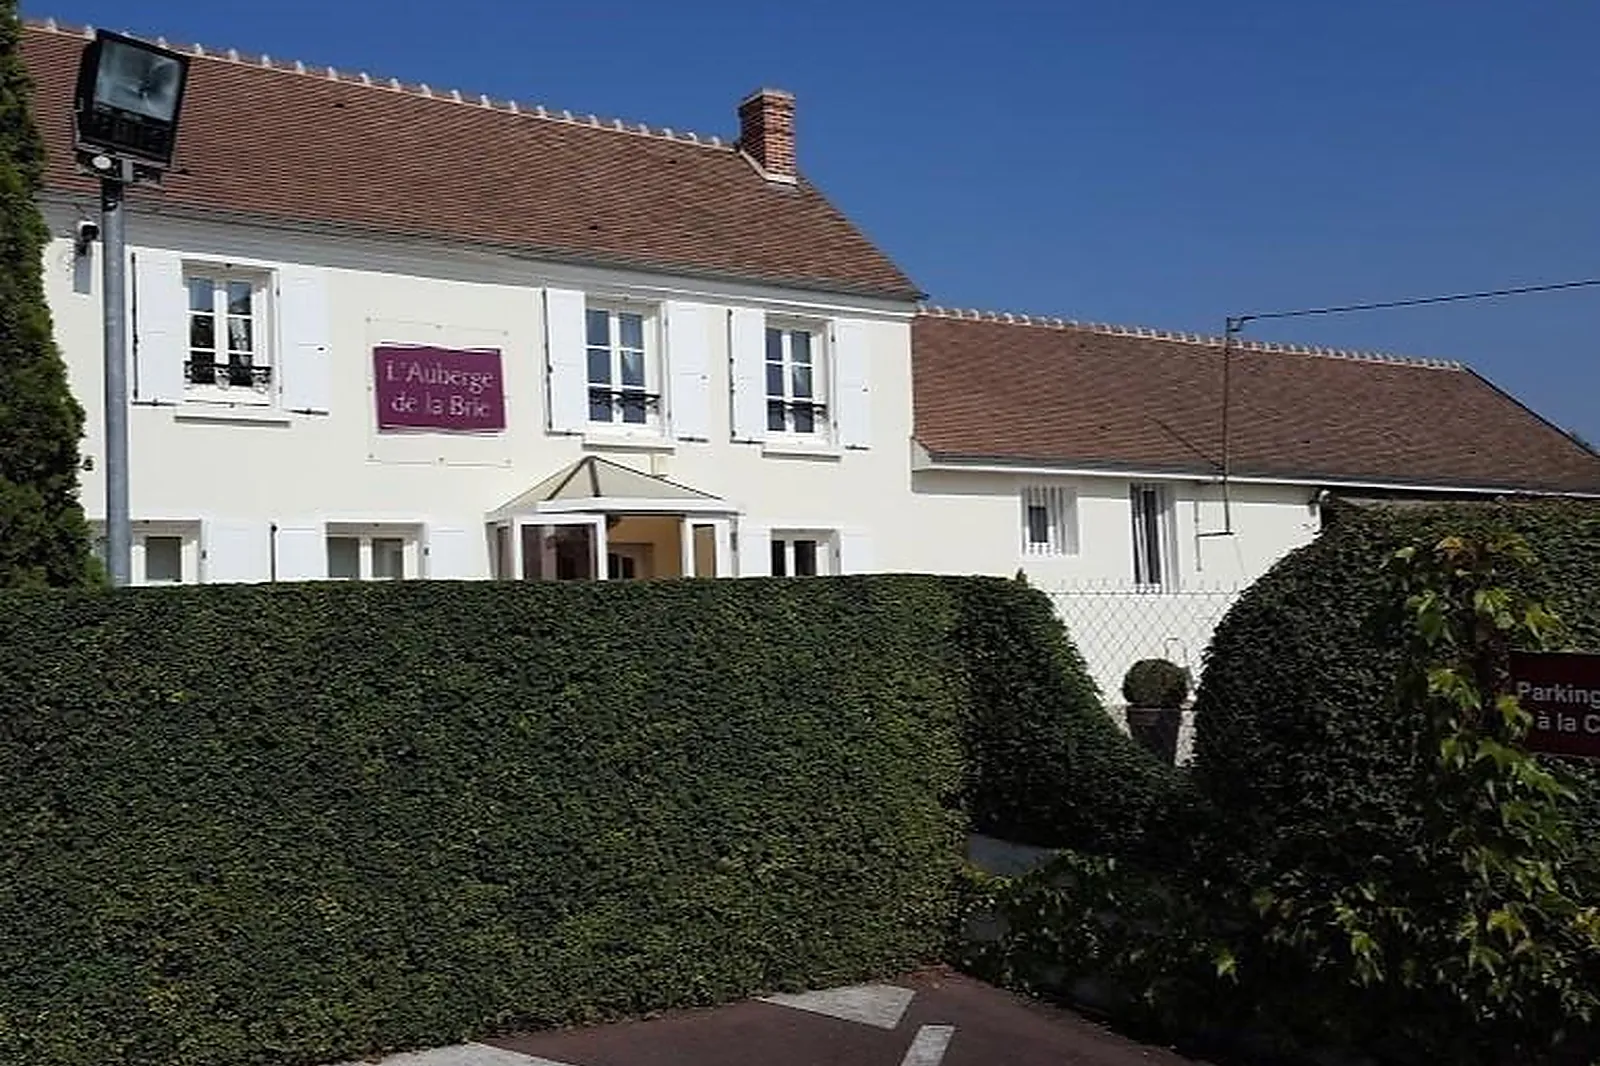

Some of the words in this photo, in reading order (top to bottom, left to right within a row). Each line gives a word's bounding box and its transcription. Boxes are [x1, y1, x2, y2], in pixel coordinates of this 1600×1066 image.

[385, 360, 494, 395] L'Auberge
[391, 391, 418, 412] de
[426, 391, 443, 415] la
[449, 394, 491, 417] Brie
[1537, 710, 1550, 730] à
[1557, 713, 1577, 732] la
